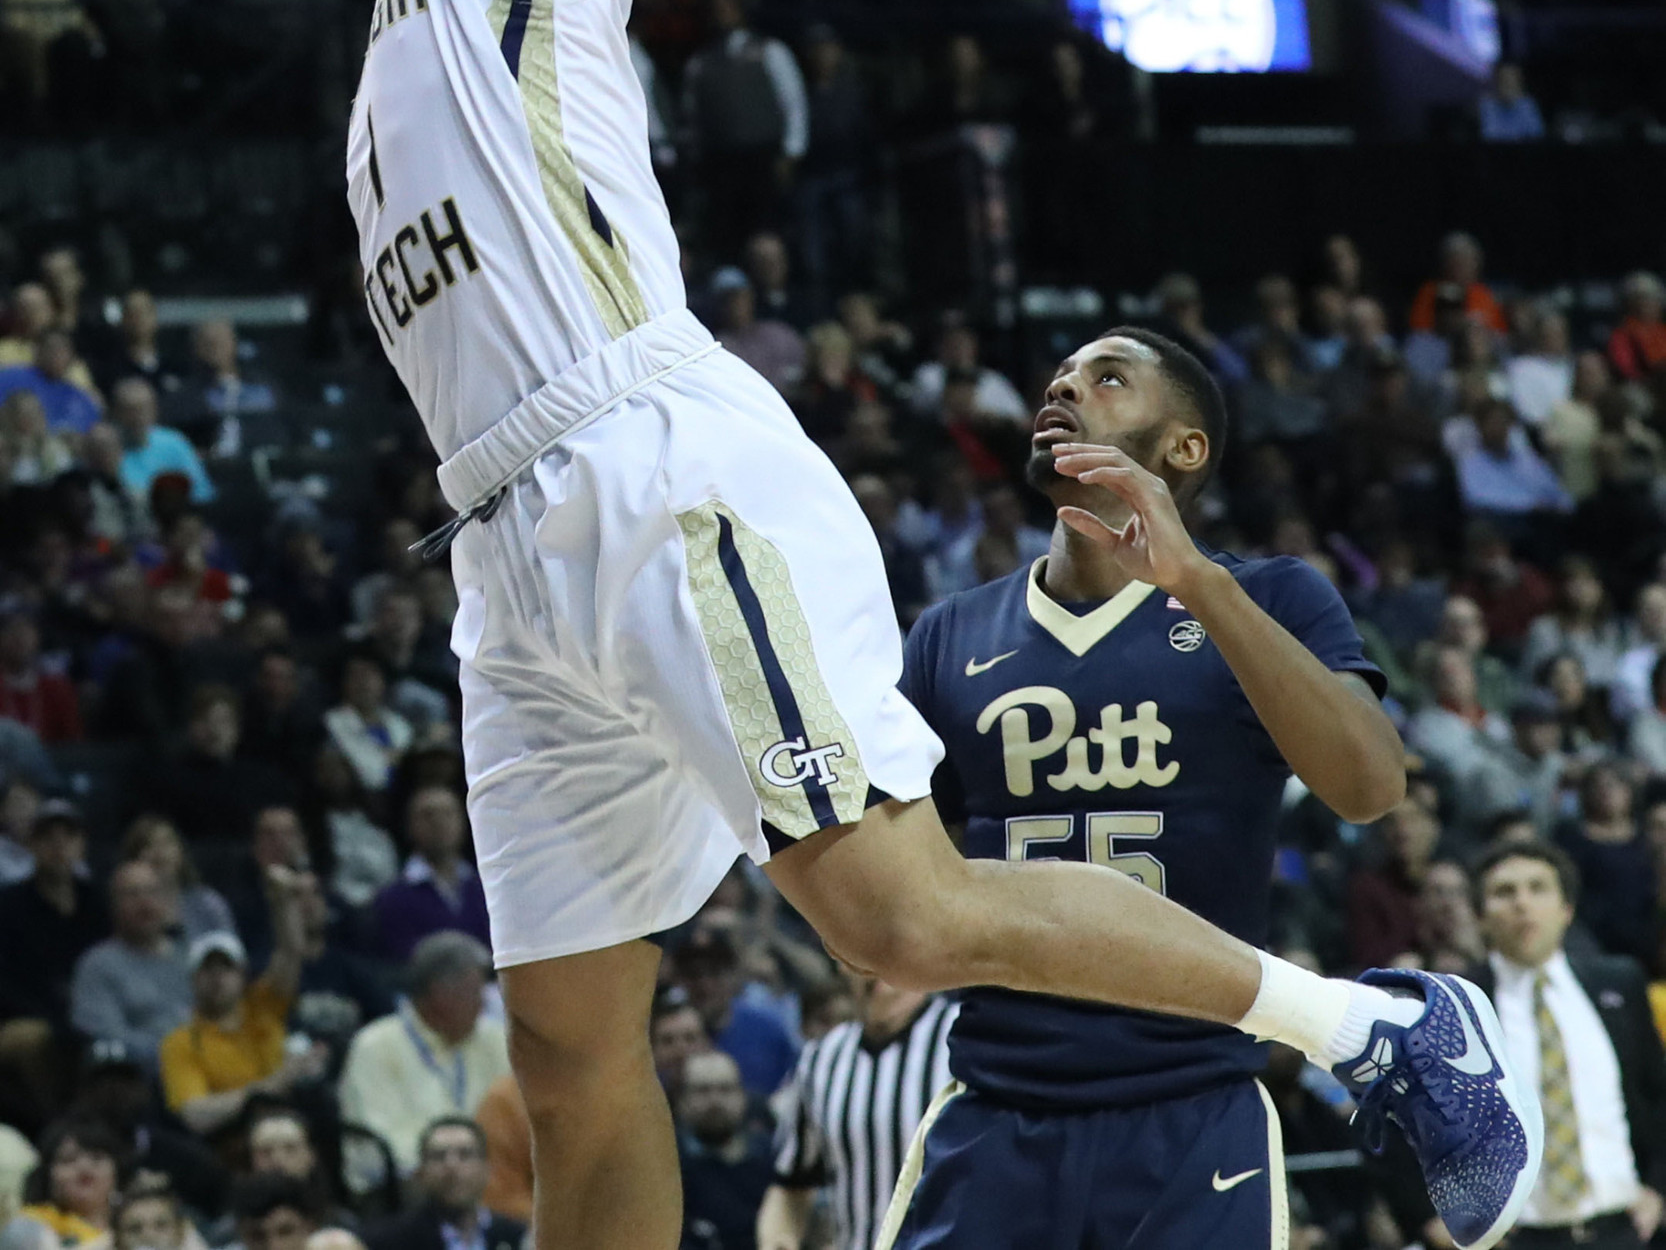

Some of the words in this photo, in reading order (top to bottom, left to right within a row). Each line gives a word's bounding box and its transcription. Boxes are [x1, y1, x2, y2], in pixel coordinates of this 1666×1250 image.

[365, 196, 481, 346] TECH
[759, 736, 845, 788] GT
[976, 685, 1180, 797] Pitt
